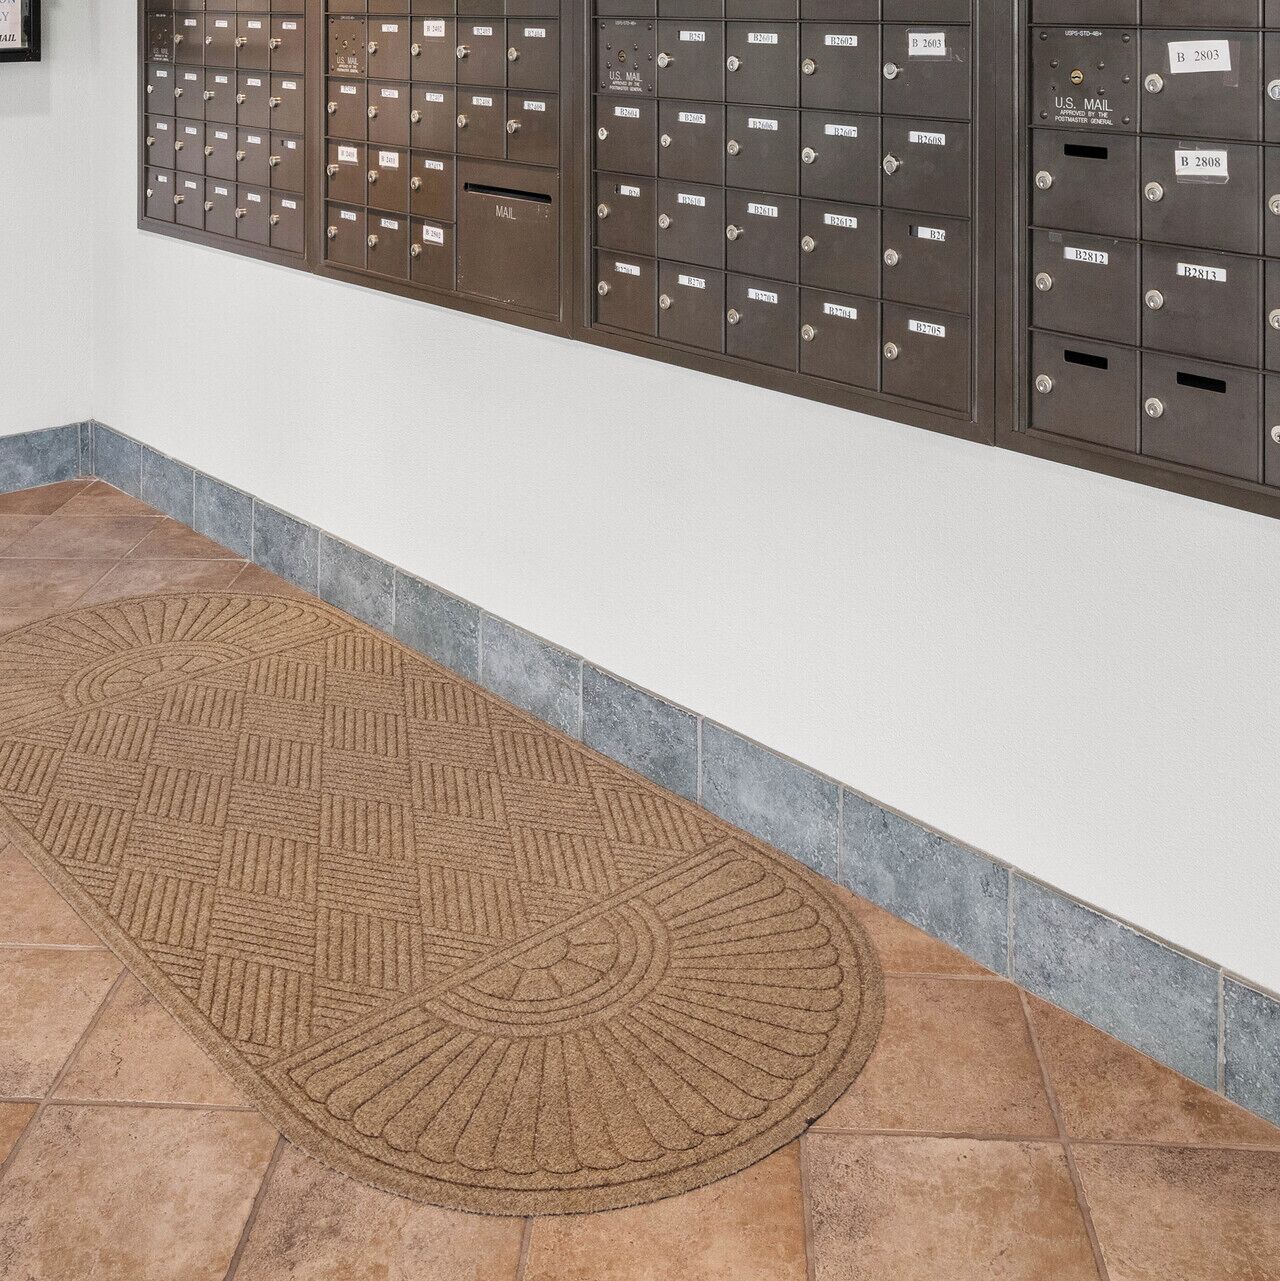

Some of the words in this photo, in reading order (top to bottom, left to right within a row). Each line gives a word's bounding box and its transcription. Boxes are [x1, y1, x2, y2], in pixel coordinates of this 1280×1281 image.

[753, 33, 773, 43] B2601
[830, 37, 853, 45] B2602
[912, 39, 918, 47] B
[923, 39, 942, 48] 2603
[1176, 52, 1186, 62] B
[1194, 50, 1220, 62] 2803
[609, 71, 622, 80] U.S.
[626, 72, 642, 82] MAIL
[1055, 96, 1076, 109] U.S.
[1084, 98, 1113, 111] MAIL
[1055, 115, 1087, 123] POSTMASTER
[834, 127, 856, 137] B2607
[917, 134, 942, 144] B2608
[1181, 157, 1189, 167] B
[1195, 156, 1221, 168] 2808
[495, 205, 516, 220] MAIL
[754, 206, 774, 215] B2611
[830, 216, 853, 226] B2612
[1075, 250, 1104, 263] B2812
[1184, 266, 1217, 280] B2813
[916, 322, 941, 336] B2705
